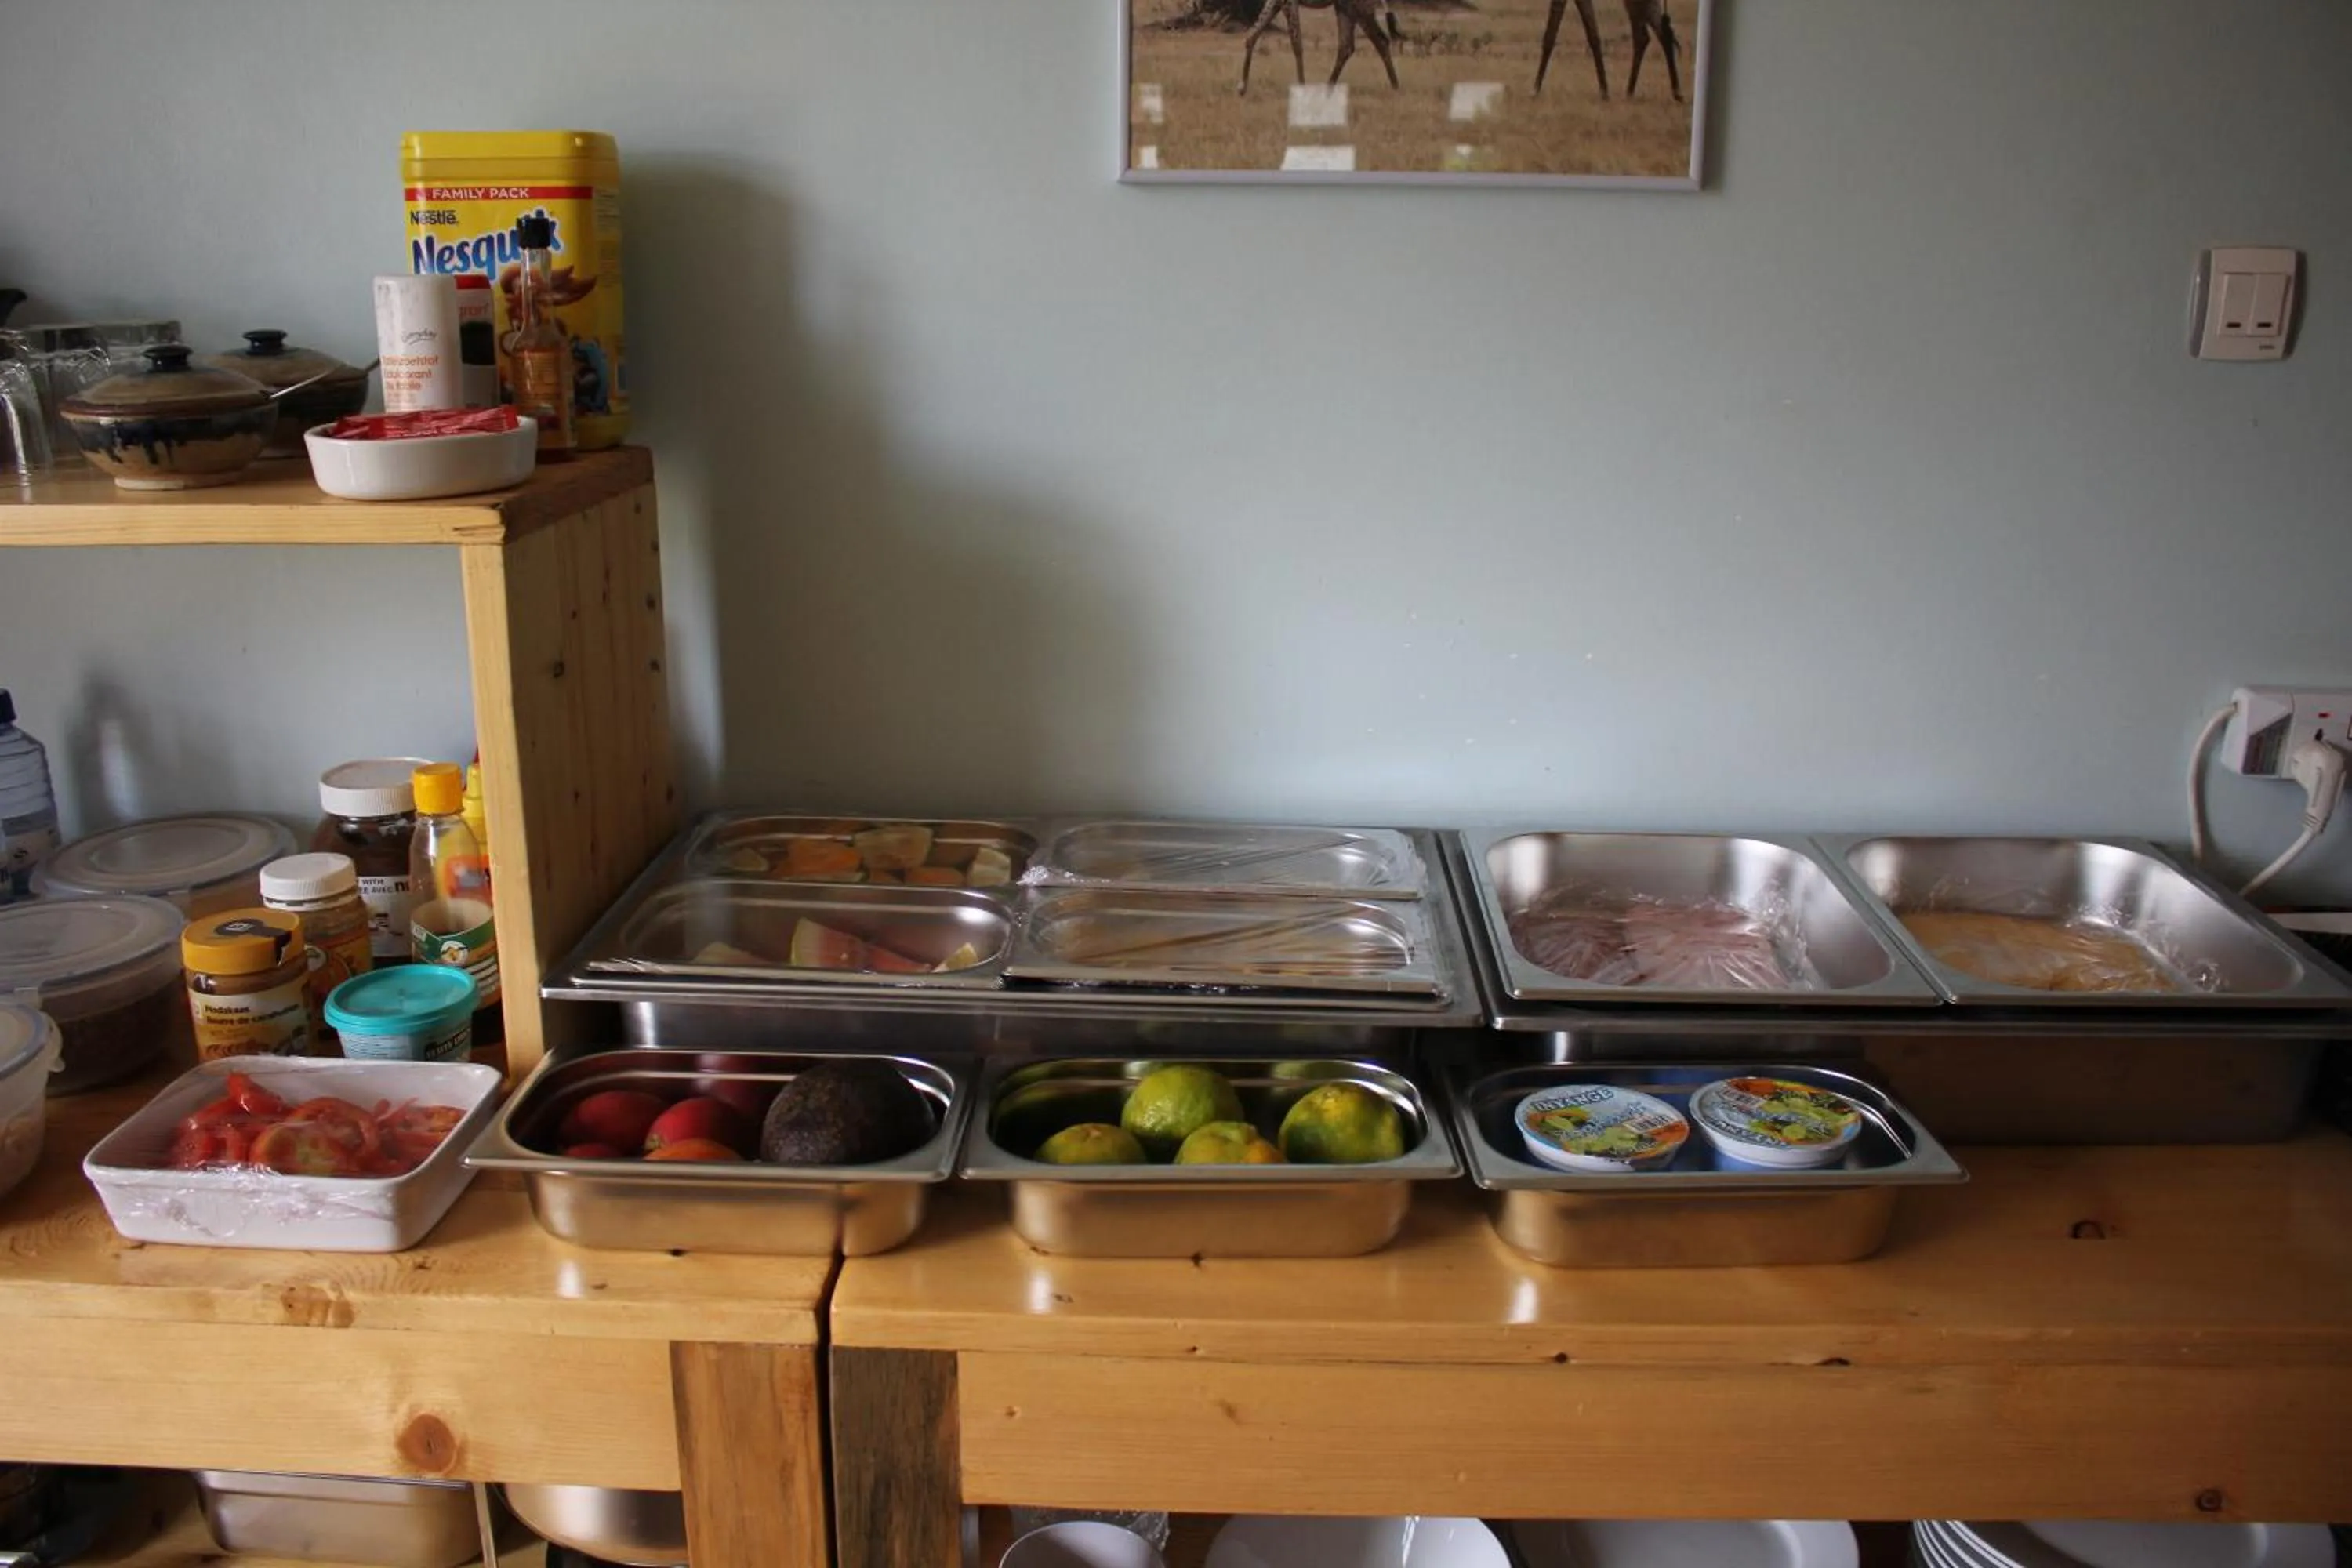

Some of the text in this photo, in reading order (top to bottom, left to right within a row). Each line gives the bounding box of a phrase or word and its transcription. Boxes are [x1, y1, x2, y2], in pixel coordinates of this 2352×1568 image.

[432, 187, 530, 199] FAMILY PACK
[412, 209, 561, 281] Nesquk
